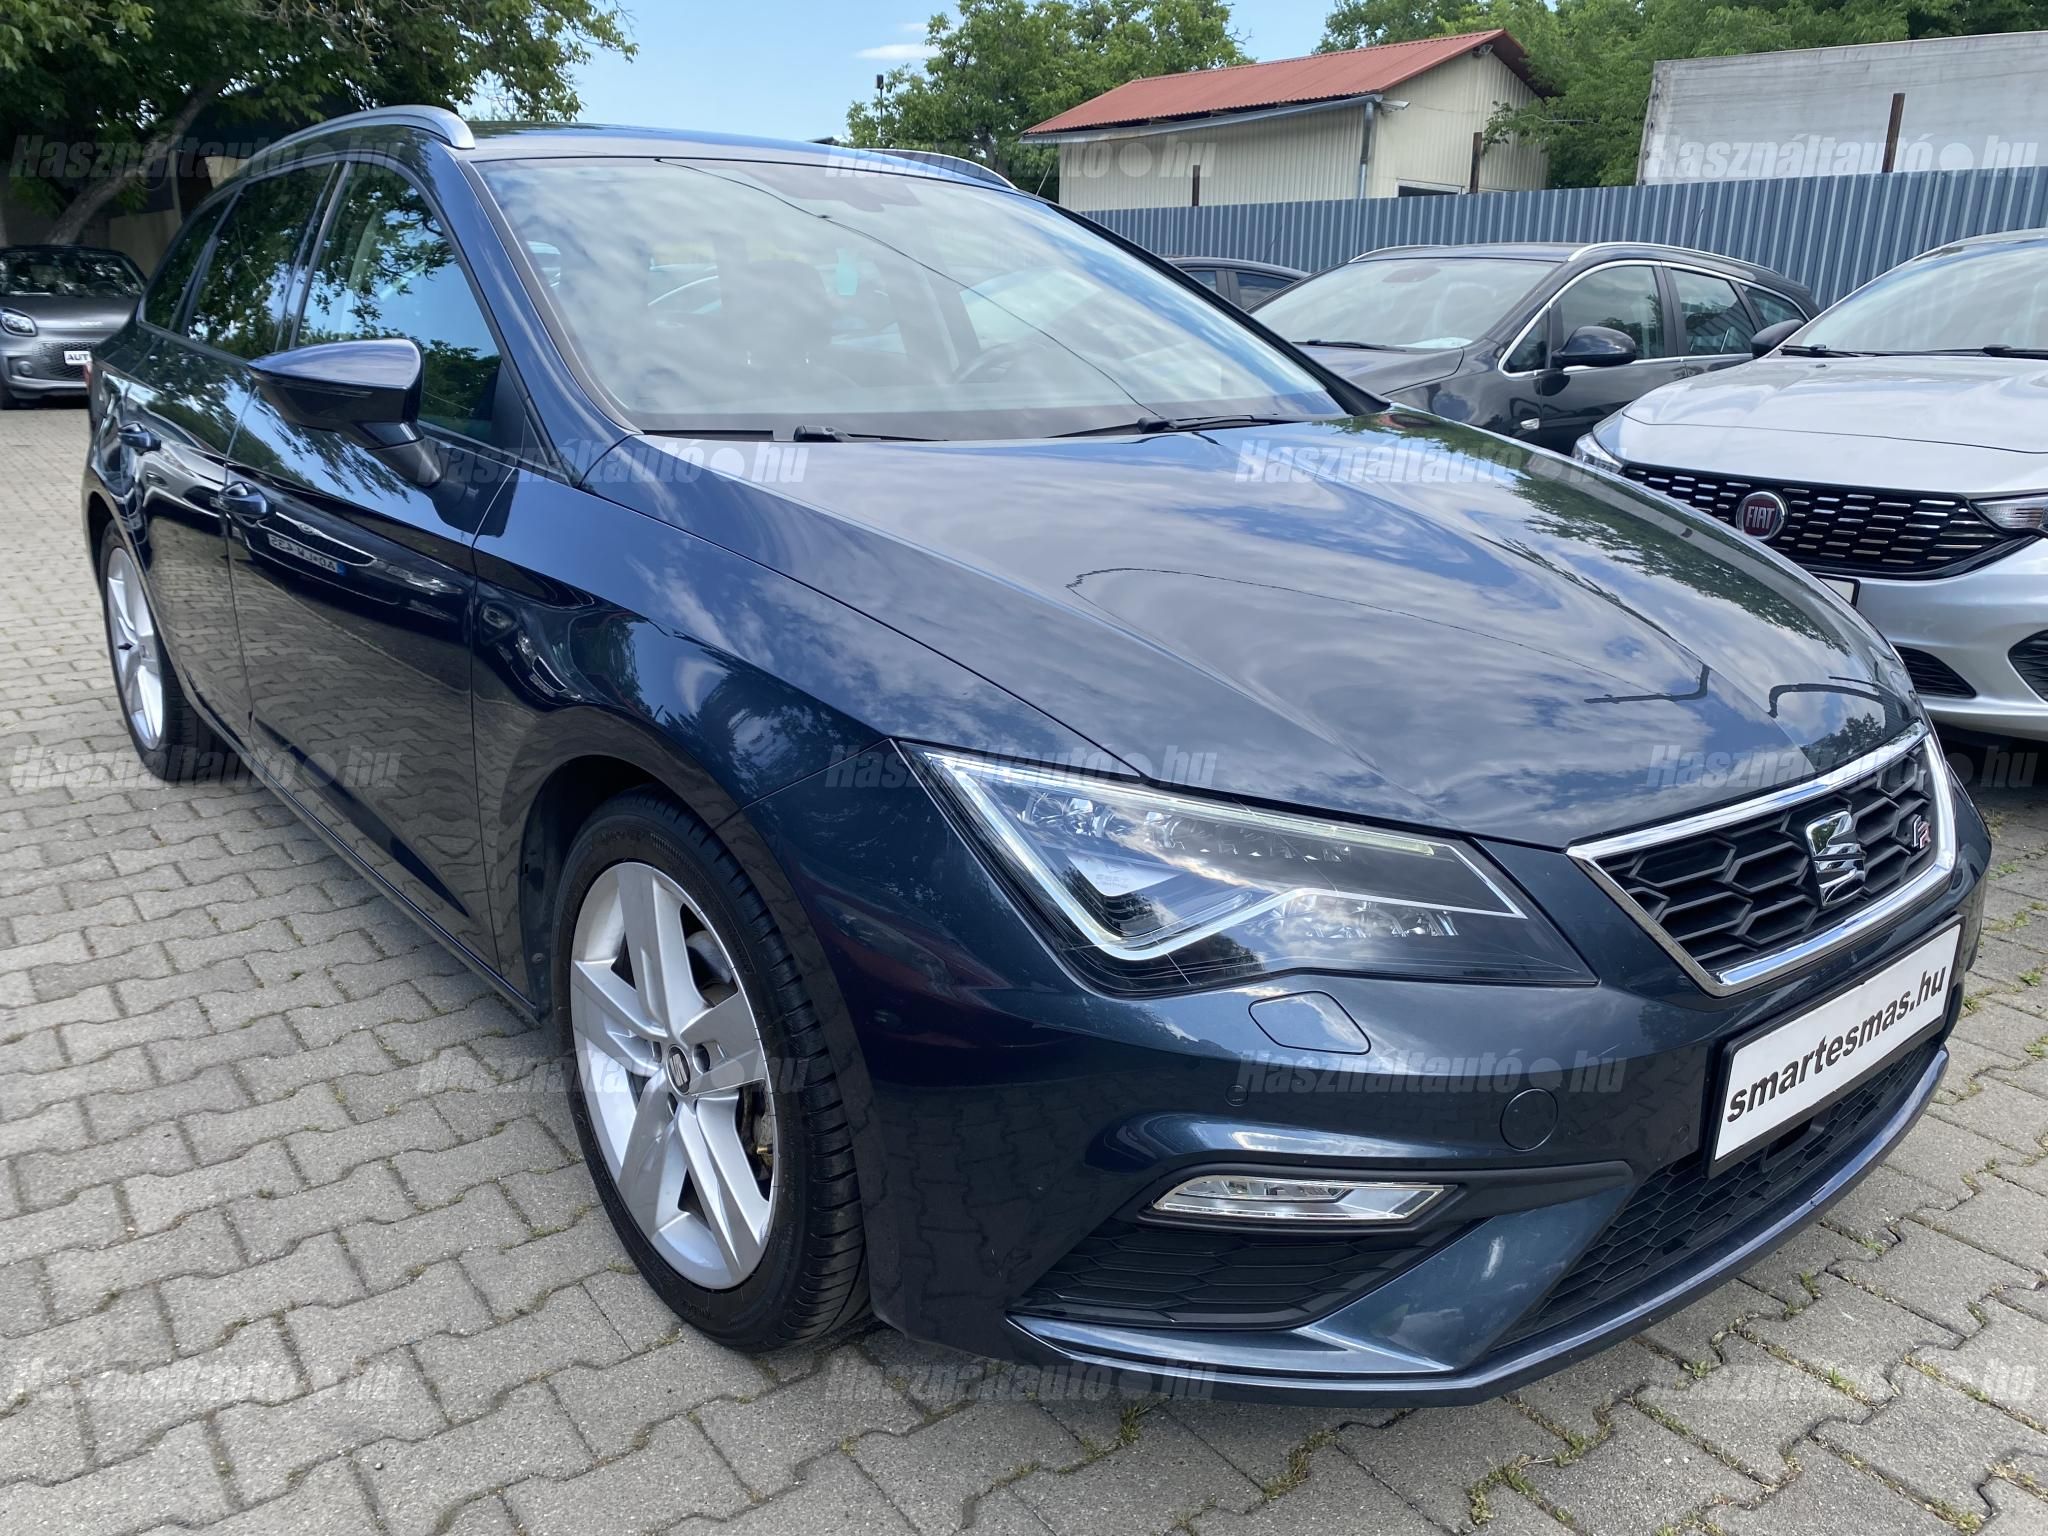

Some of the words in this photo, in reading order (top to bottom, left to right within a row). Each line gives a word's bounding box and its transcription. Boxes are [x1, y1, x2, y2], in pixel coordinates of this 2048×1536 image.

[66, 353, 89, 361] AUT
[1744, 505, 1775, 529] FIAT
[1726, 965, 1947, 1122] smartesmas.hu
